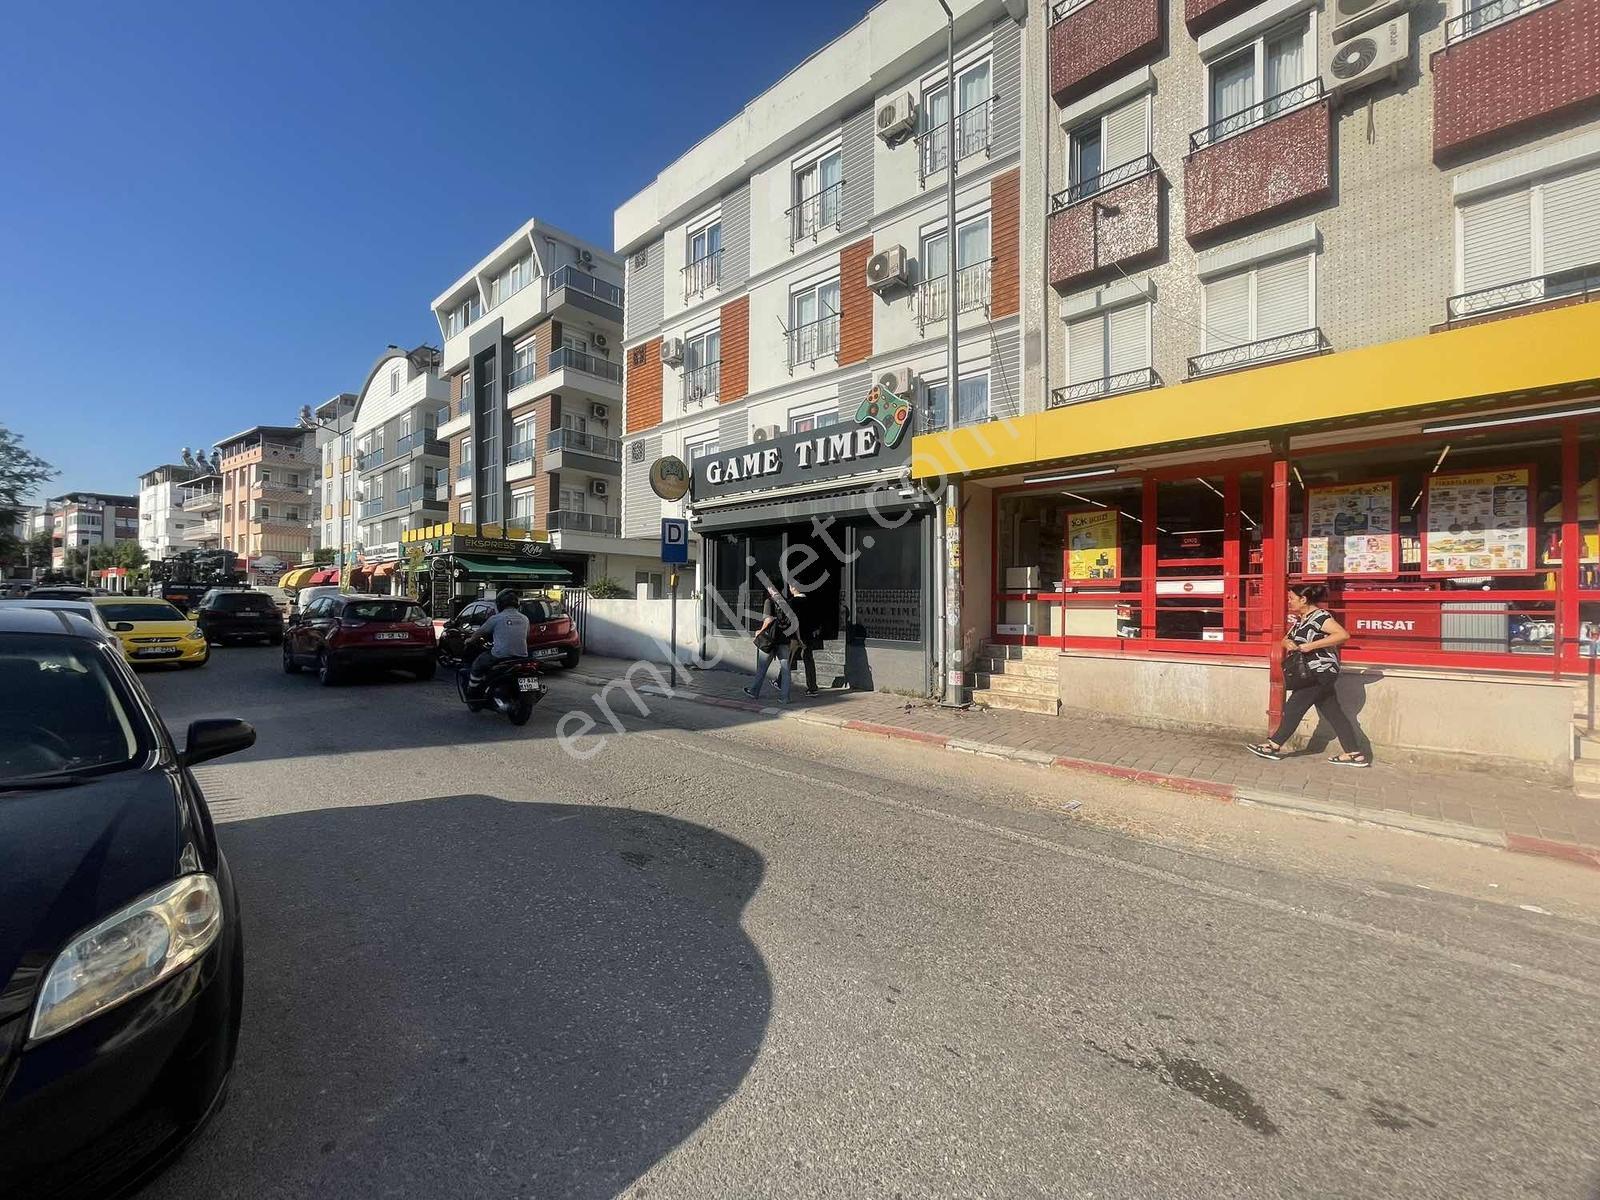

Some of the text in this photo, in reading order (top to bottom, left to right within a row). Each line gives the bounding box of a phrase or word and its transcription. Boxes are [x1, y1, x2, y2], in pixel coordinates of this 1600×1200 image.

[706, 427, 877, 485] GAME TIME
[668, 524, 681, 543] D
[465, 539, 516, 550] EKSPRESS
[856, 606, 918, 617] GAME TIME
[1356, 619, 1416, 631] FIRSAT
